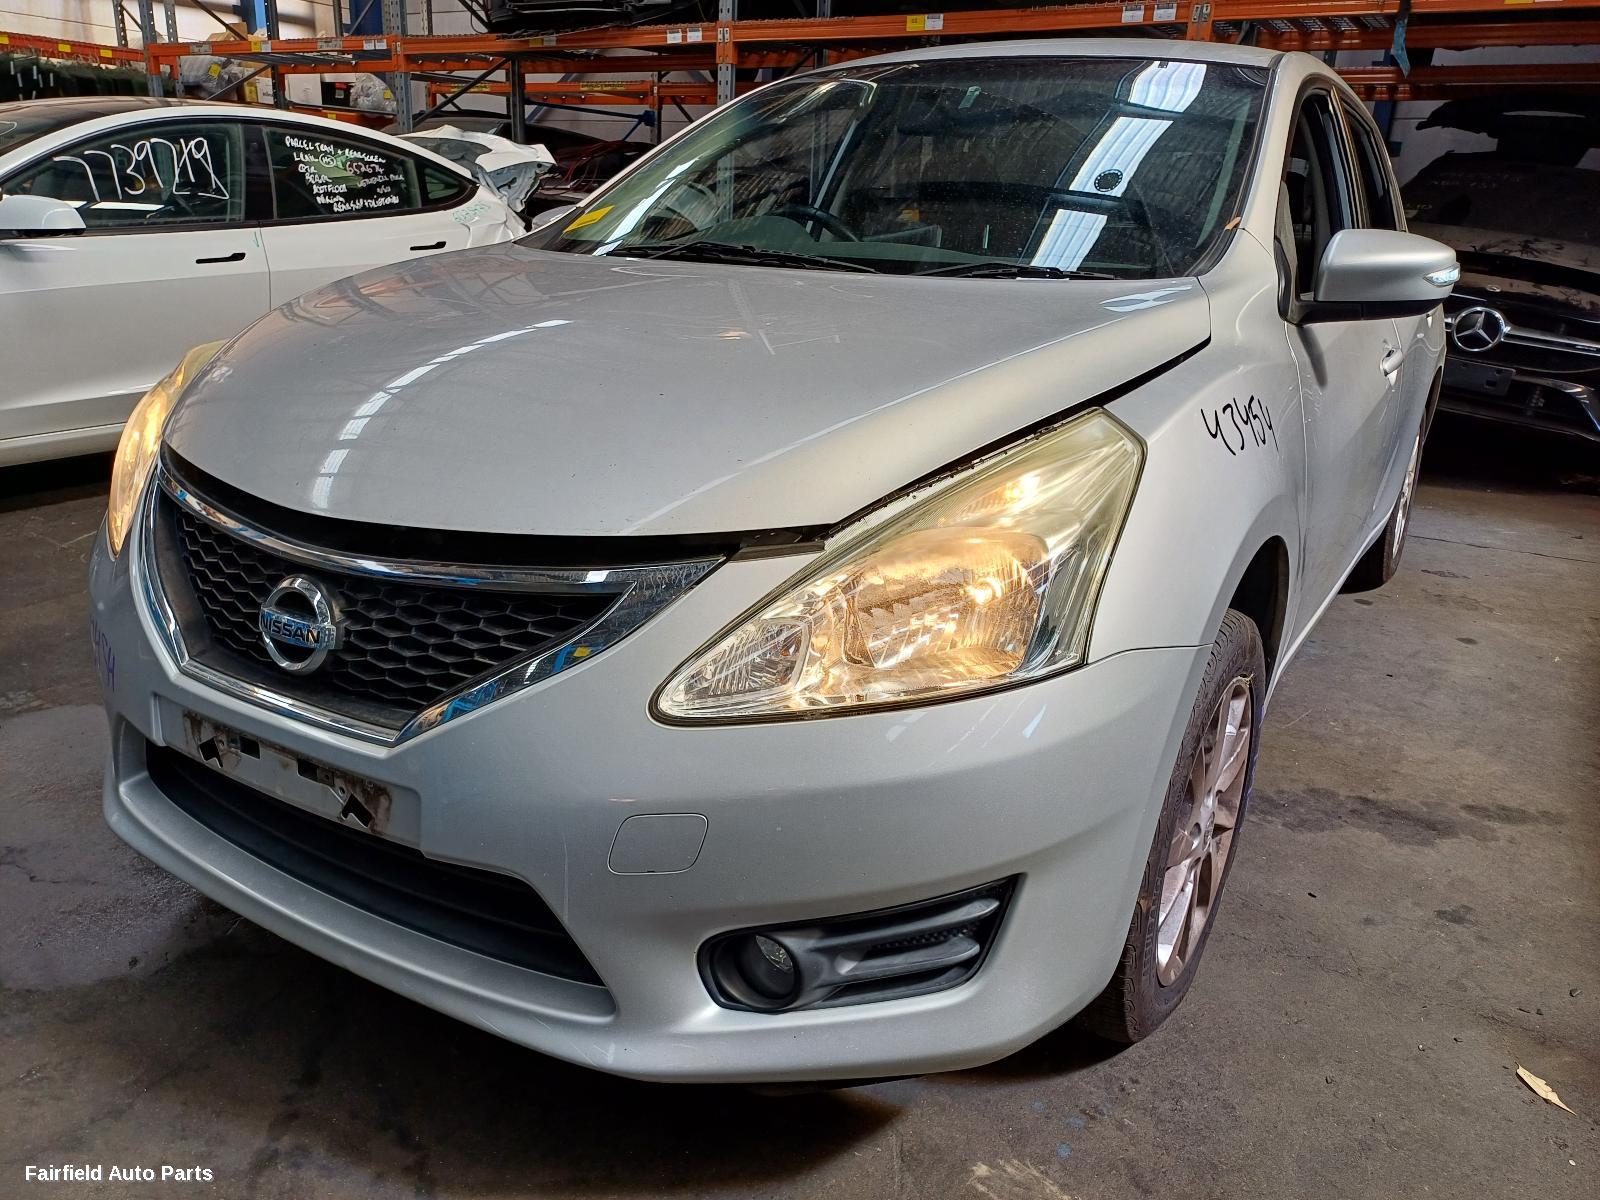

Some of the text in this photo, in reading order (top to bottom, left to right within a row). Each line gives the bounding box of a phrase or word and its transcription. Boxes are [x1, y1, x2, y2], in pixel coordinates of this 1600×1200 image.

[285, 135, 314, 150] PARCEL
[315, 142, 335, 155] TRAY
[261, 612, 320, 644] NISSAN
